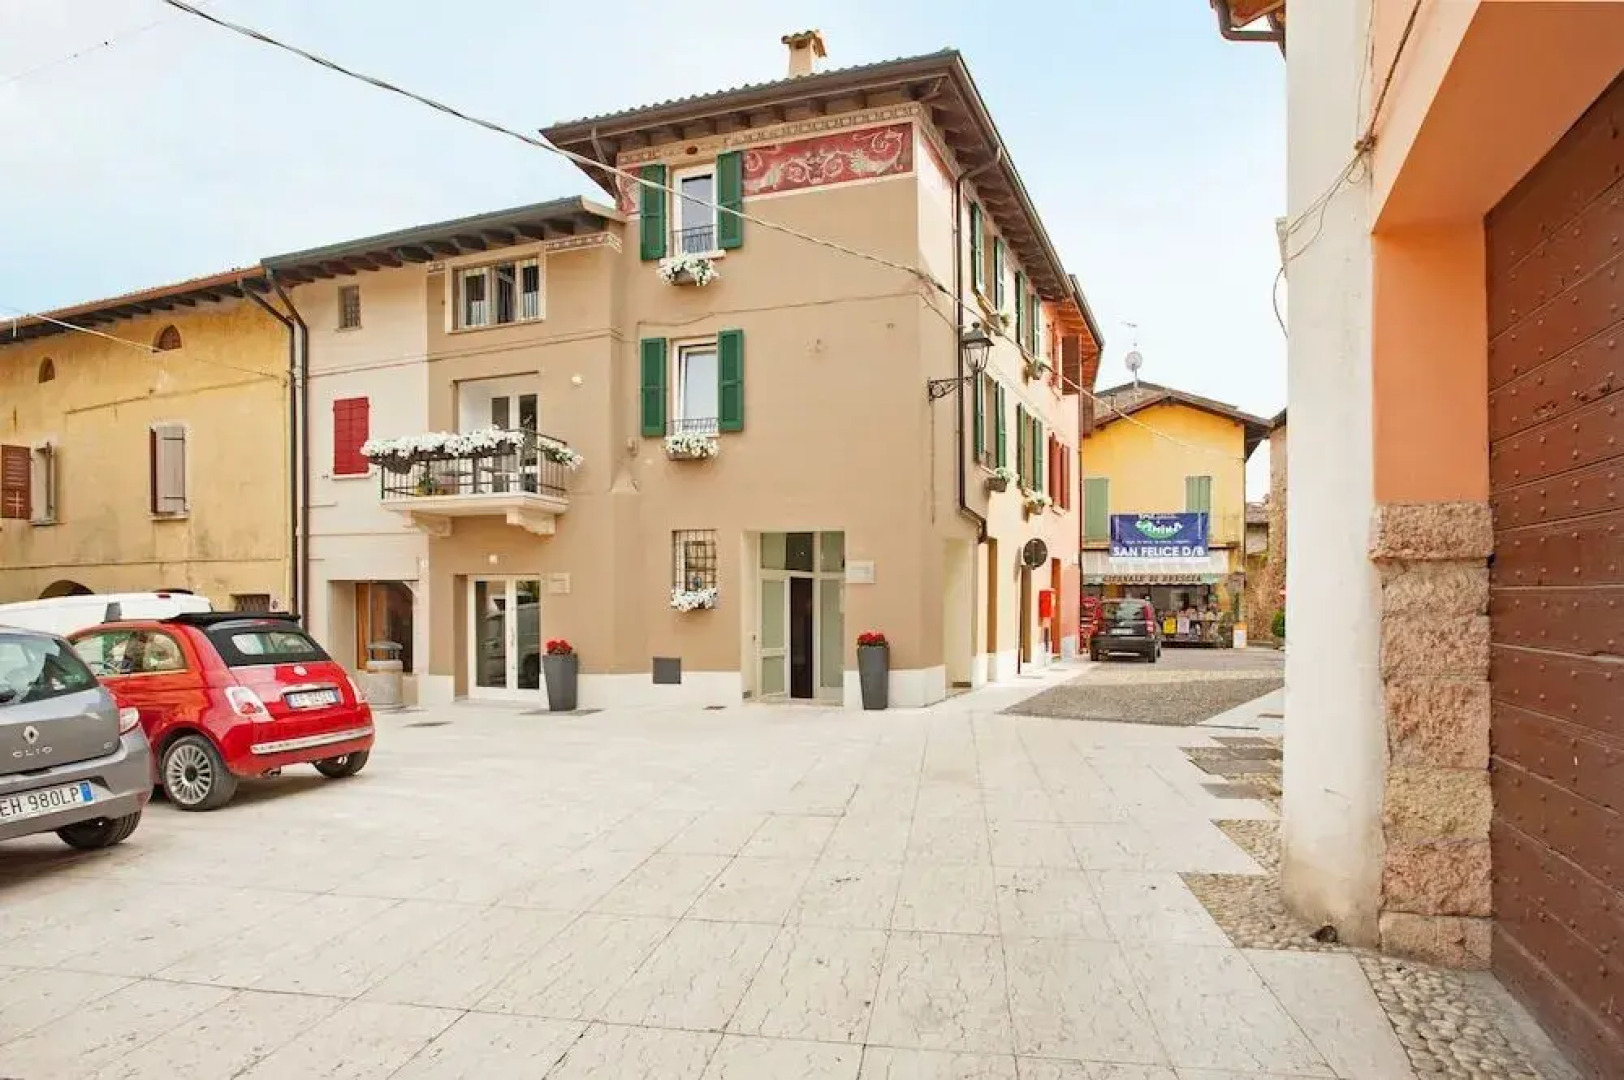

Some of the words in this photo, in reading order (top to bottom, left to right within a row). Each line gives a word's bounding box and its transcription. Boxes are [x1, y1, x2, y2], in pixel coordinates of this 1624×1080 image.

[1113, 546, 1138, 557] SAN
[1141, 546, 1179, 557] FELICE
[1182, 546, 1204, 557] D/B
[27, 787, 79, 811] 980LP
